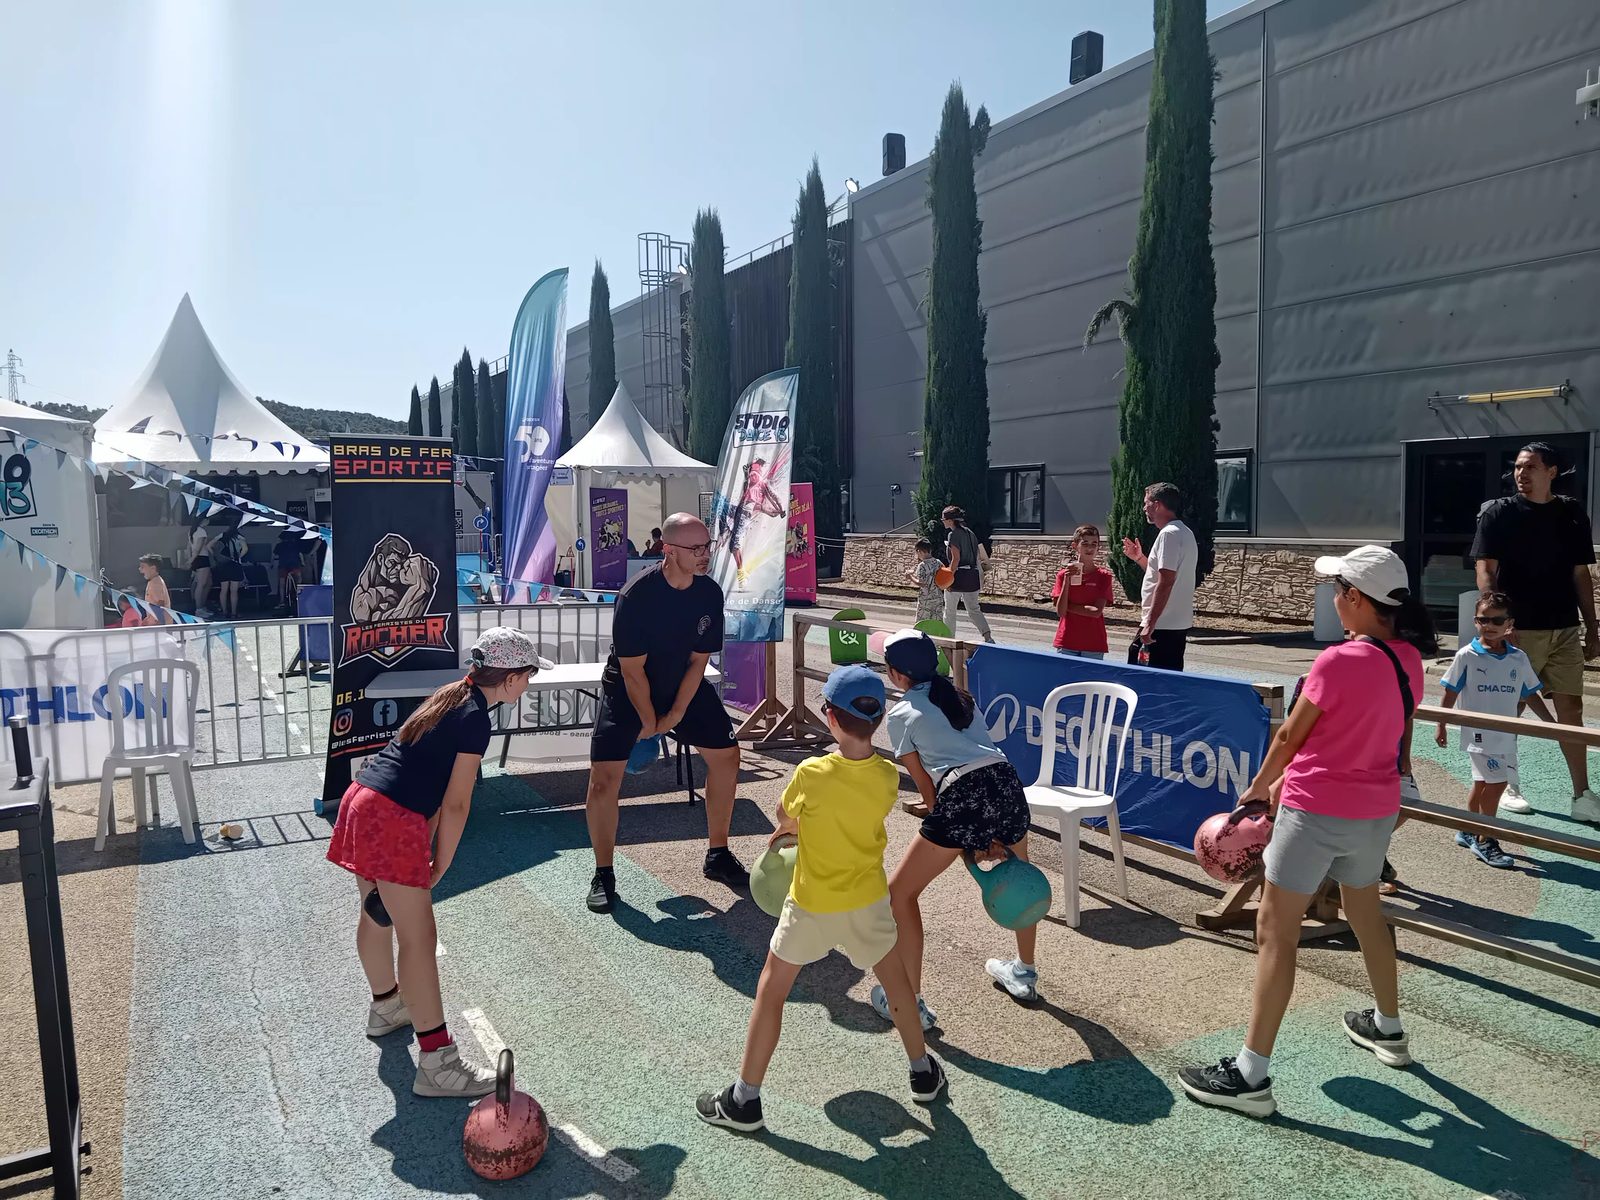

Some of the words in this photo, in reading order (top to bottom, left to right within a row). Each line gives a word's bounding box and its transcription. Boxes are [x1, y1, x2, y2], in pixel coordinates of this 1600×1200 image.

[735, 413, 790, 430] STUDIO
[333, 445, 382, 456] BRAS
[389, 446, 412, 457] DE
[419, 447, 452, 458] FER
[514, 426, 550, 463] 50
[334, 459, 452, 476] SPORTIF
[738, 597, 750, 605] de
[344, 617, 446, 660] ROCHER
[1477, 684, 1500, 693] CMA
